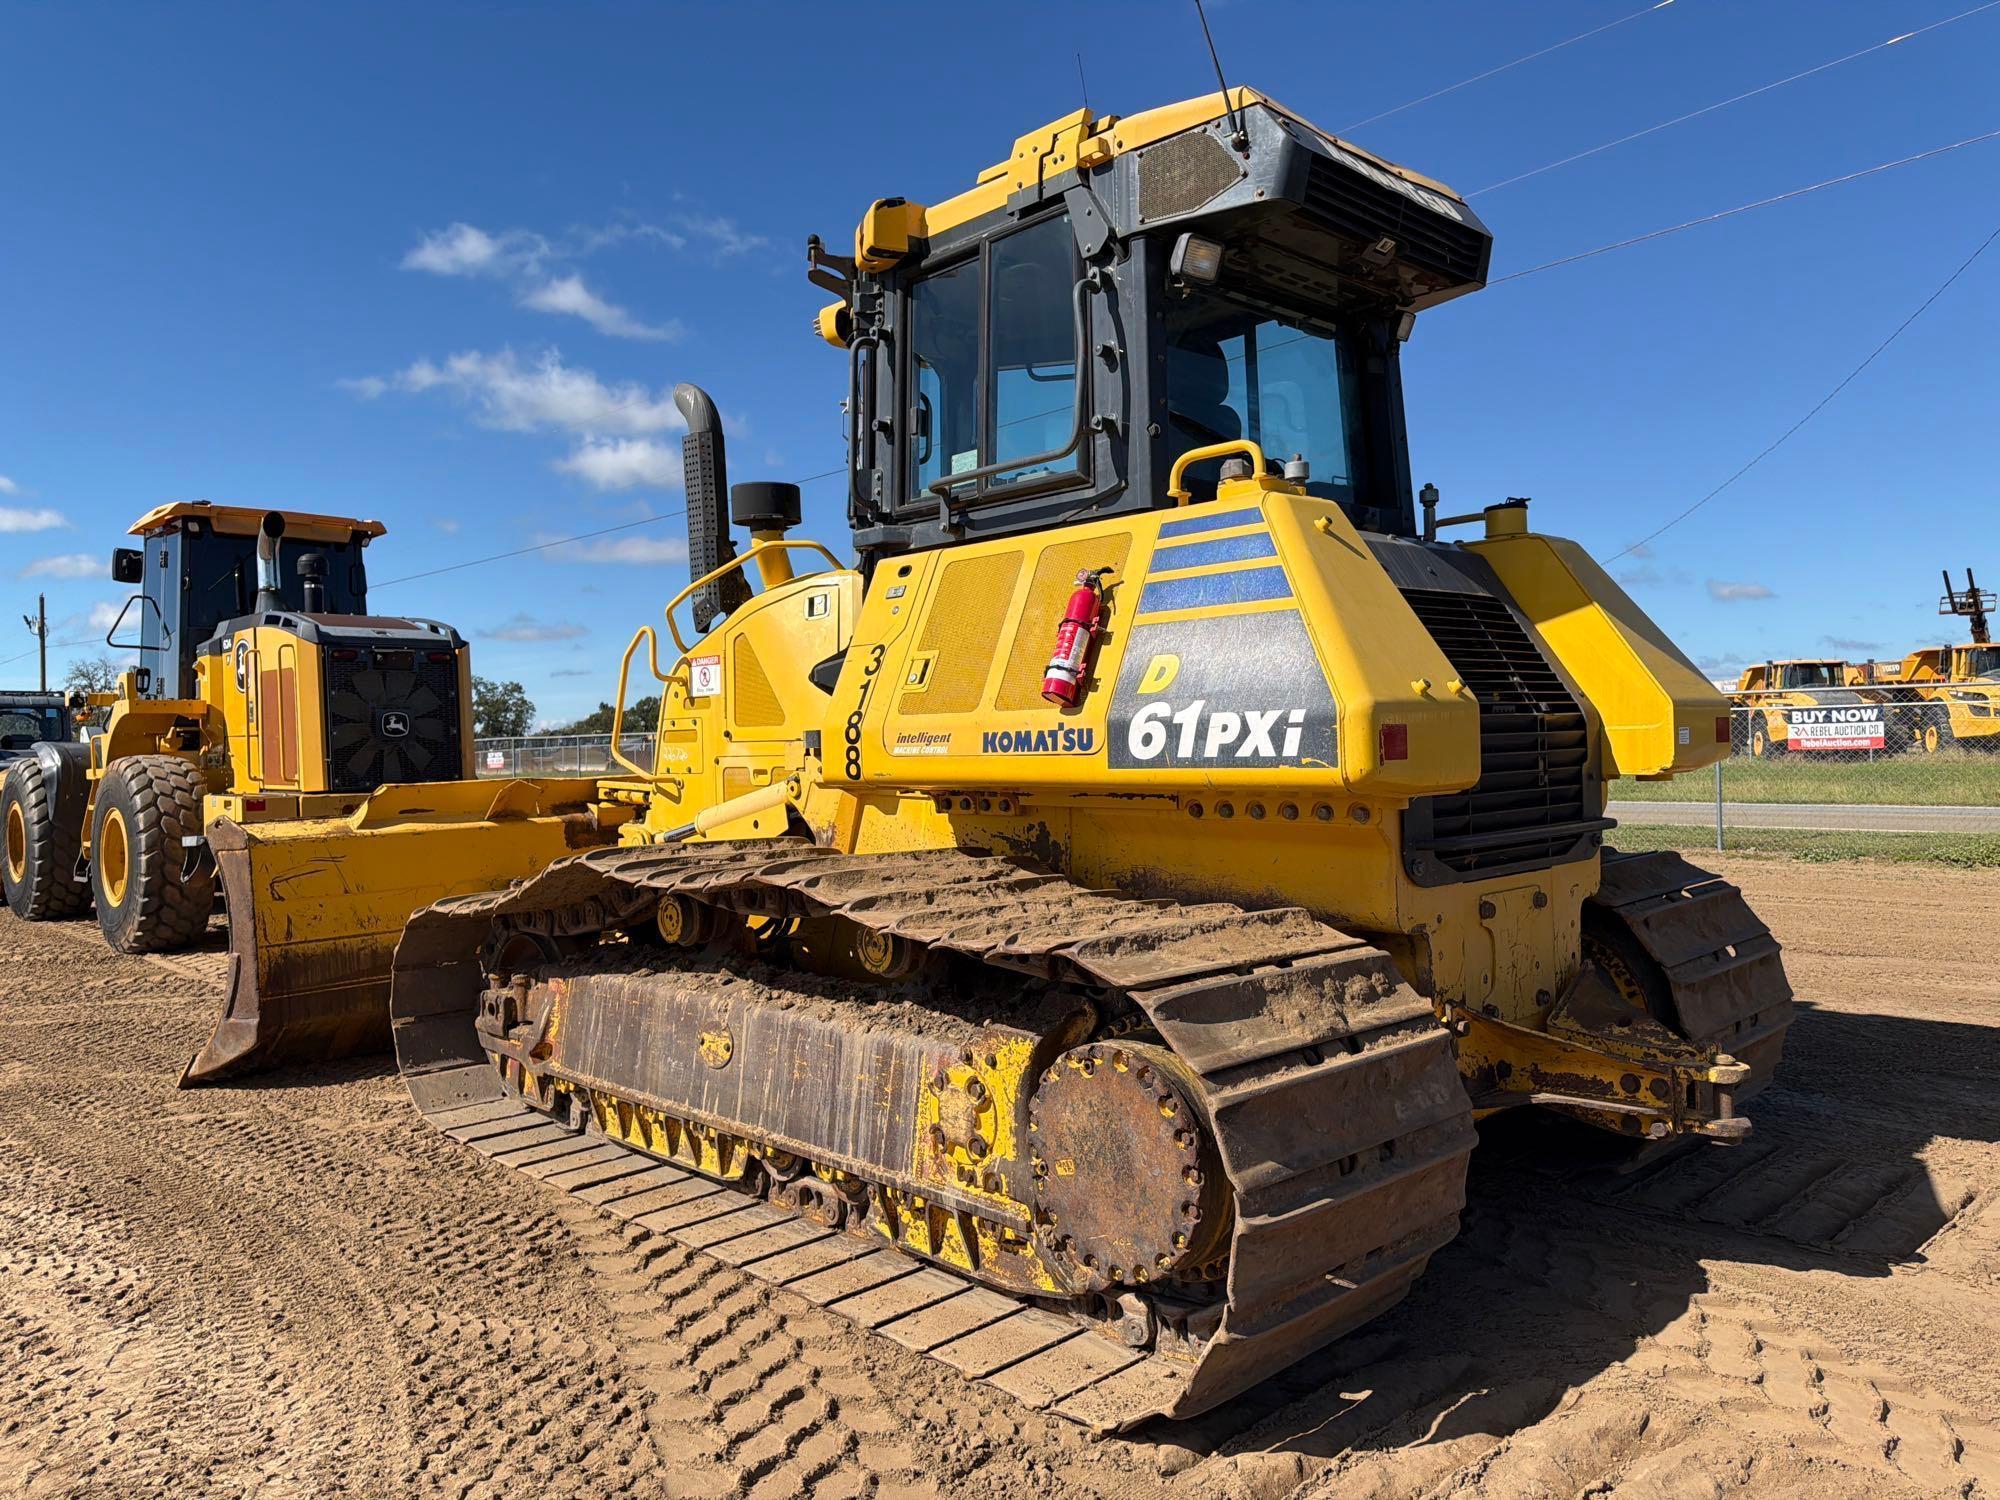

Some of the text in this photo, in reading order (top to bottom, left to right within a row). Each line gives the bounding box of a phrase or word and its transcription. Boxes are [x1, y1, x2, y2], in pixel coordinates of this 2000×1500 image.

[696, 656, 719, 666] DANGER
[1137, 653, 1180, 694] D
[844, 644, 886, 781] 3188
[1791, 708, 1878, 724] BUY NOW
[982, 722, 1094, 753] KOMATSU
[1128, 700, 1307, 760] 61PXi
[1810, 726, 1832, 737] REBEL
[1834, 725, 1866, 736] AUCTION
[1868, 724, 1882, 735] CO.
[896, 732, 952, 747] intelligent
[1800, 739, 1871, 748] RebelAuction.com
[893, 745, 949, 754] MACHINE CONTROL
